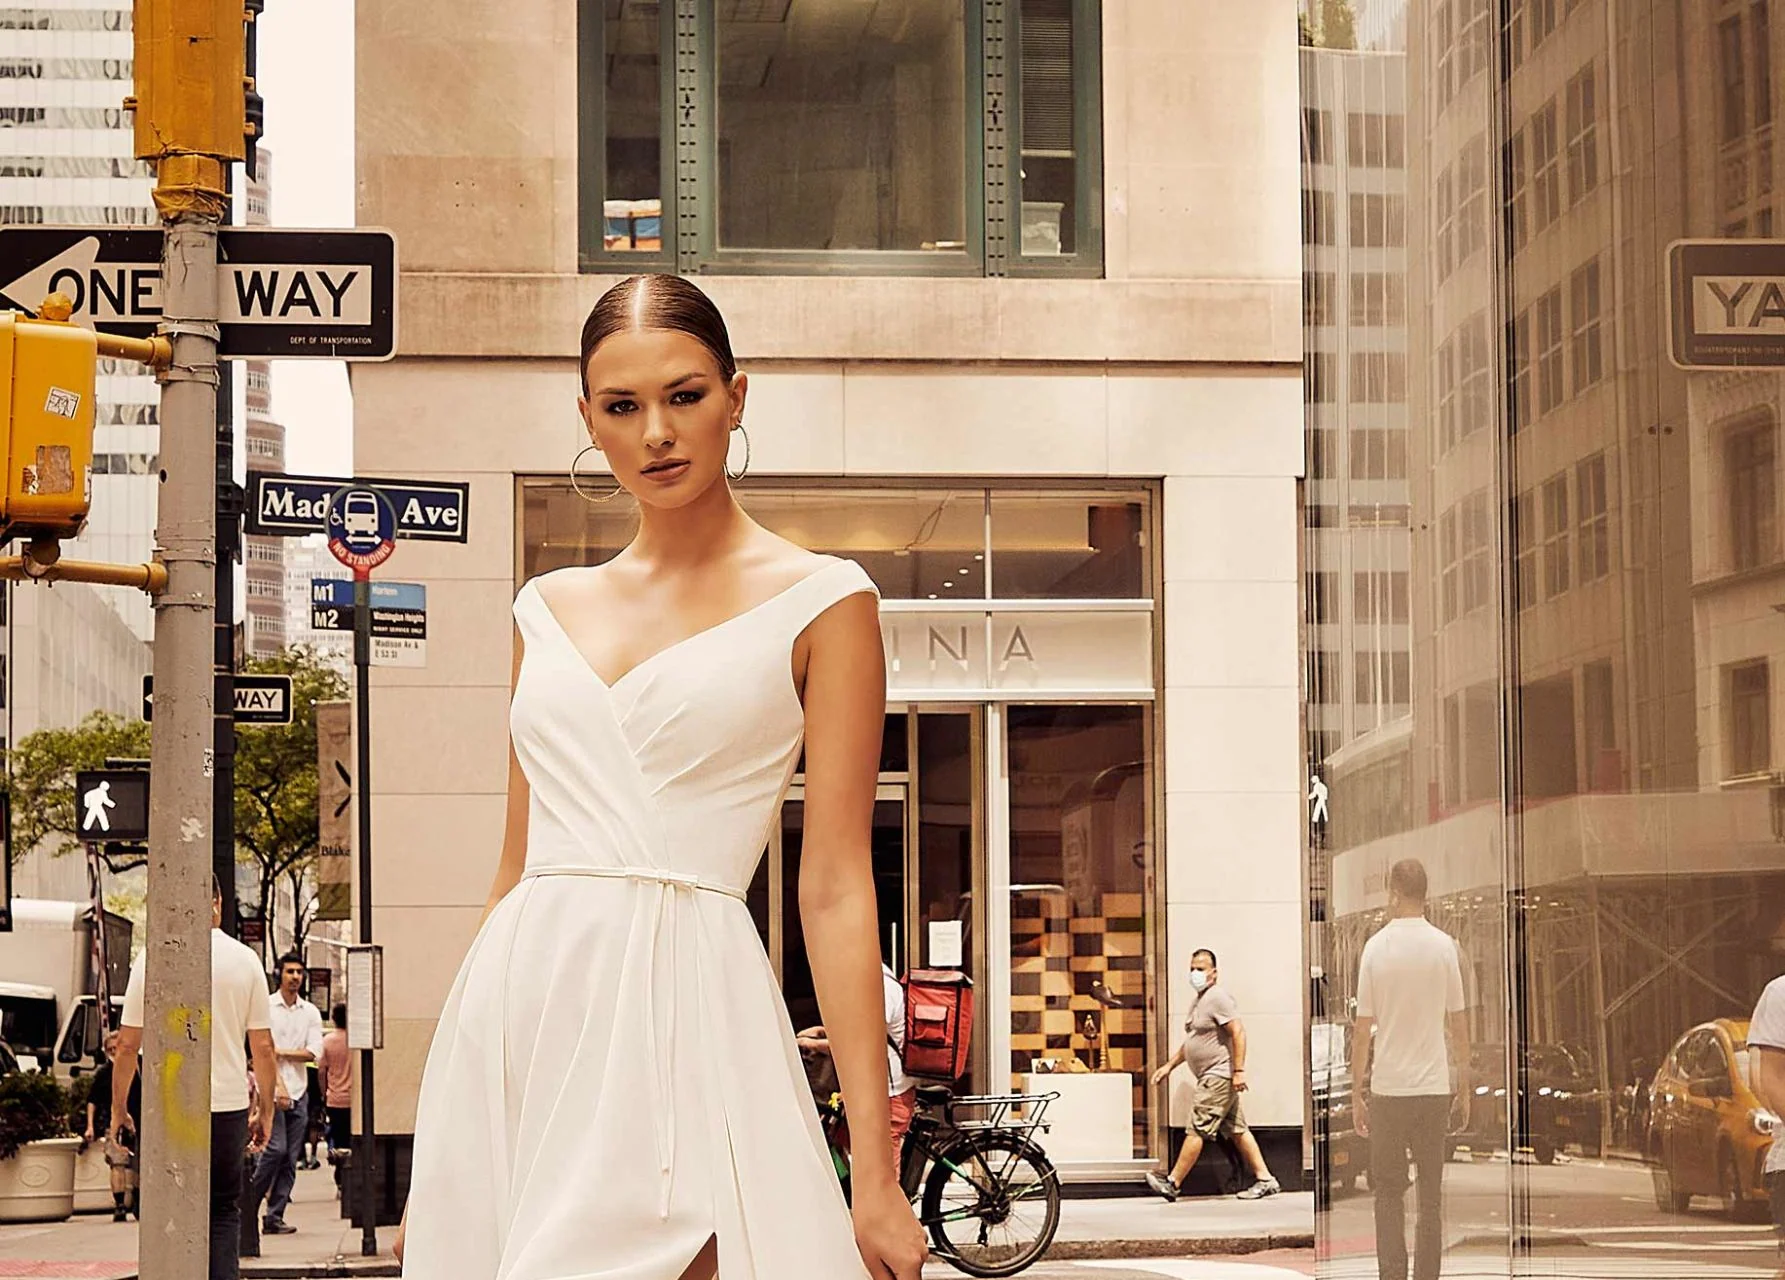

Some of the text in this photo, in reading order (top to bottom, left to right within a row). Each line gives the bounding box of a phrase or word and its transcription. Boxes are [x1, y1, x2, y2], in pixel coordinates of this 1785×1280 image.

[48, 268, 359, 318] ONE WAY
[290, 336, 372, 345] DEPT OF TRANSPORTATION
[401, 498, 458, 526] Ave
[333, 542, 391, 565] NO STANDING
[314, 583, 334, 602] M1
[314, 609, 339, 628] M2
